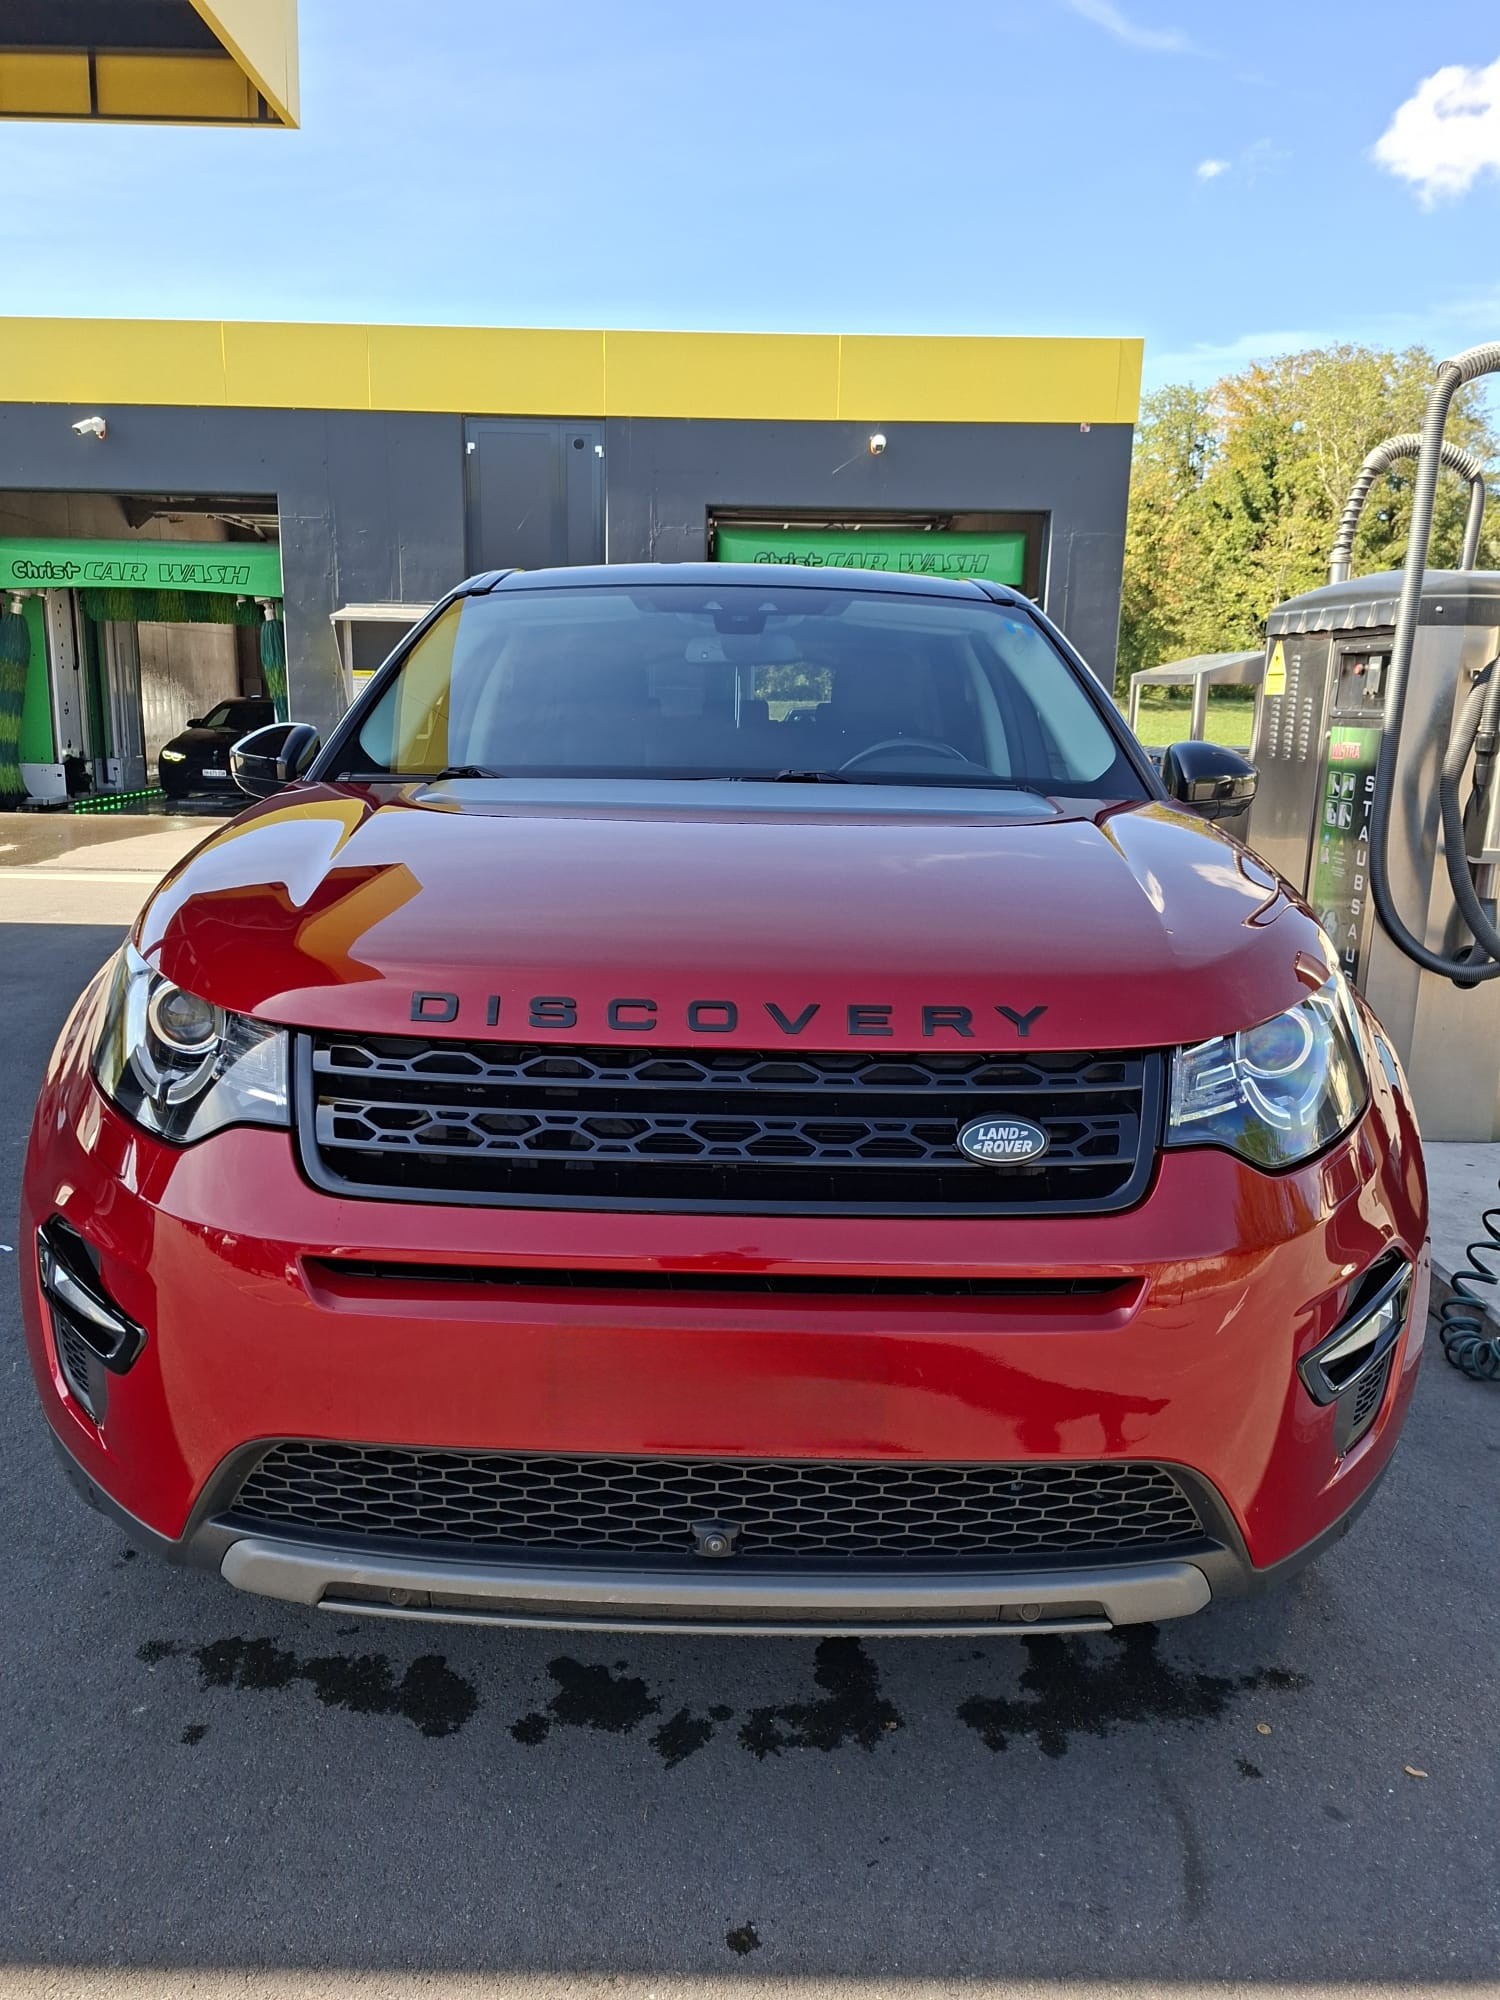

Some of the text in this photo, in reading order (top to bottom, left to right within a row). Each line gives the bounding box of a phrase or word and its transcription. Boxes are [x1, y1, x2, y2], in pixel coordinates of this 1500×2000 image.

[12, 560, 250, 585] Christ CAR WASH
[826, 552, 889, 571] CAR
[899, 553, 990, 574] WASH
[409, 990, 1049, 1038] DISCOVERY
[977, 1127, 1019, 1140] LAND
[982, 1140, 1033, 1153] ROVER
